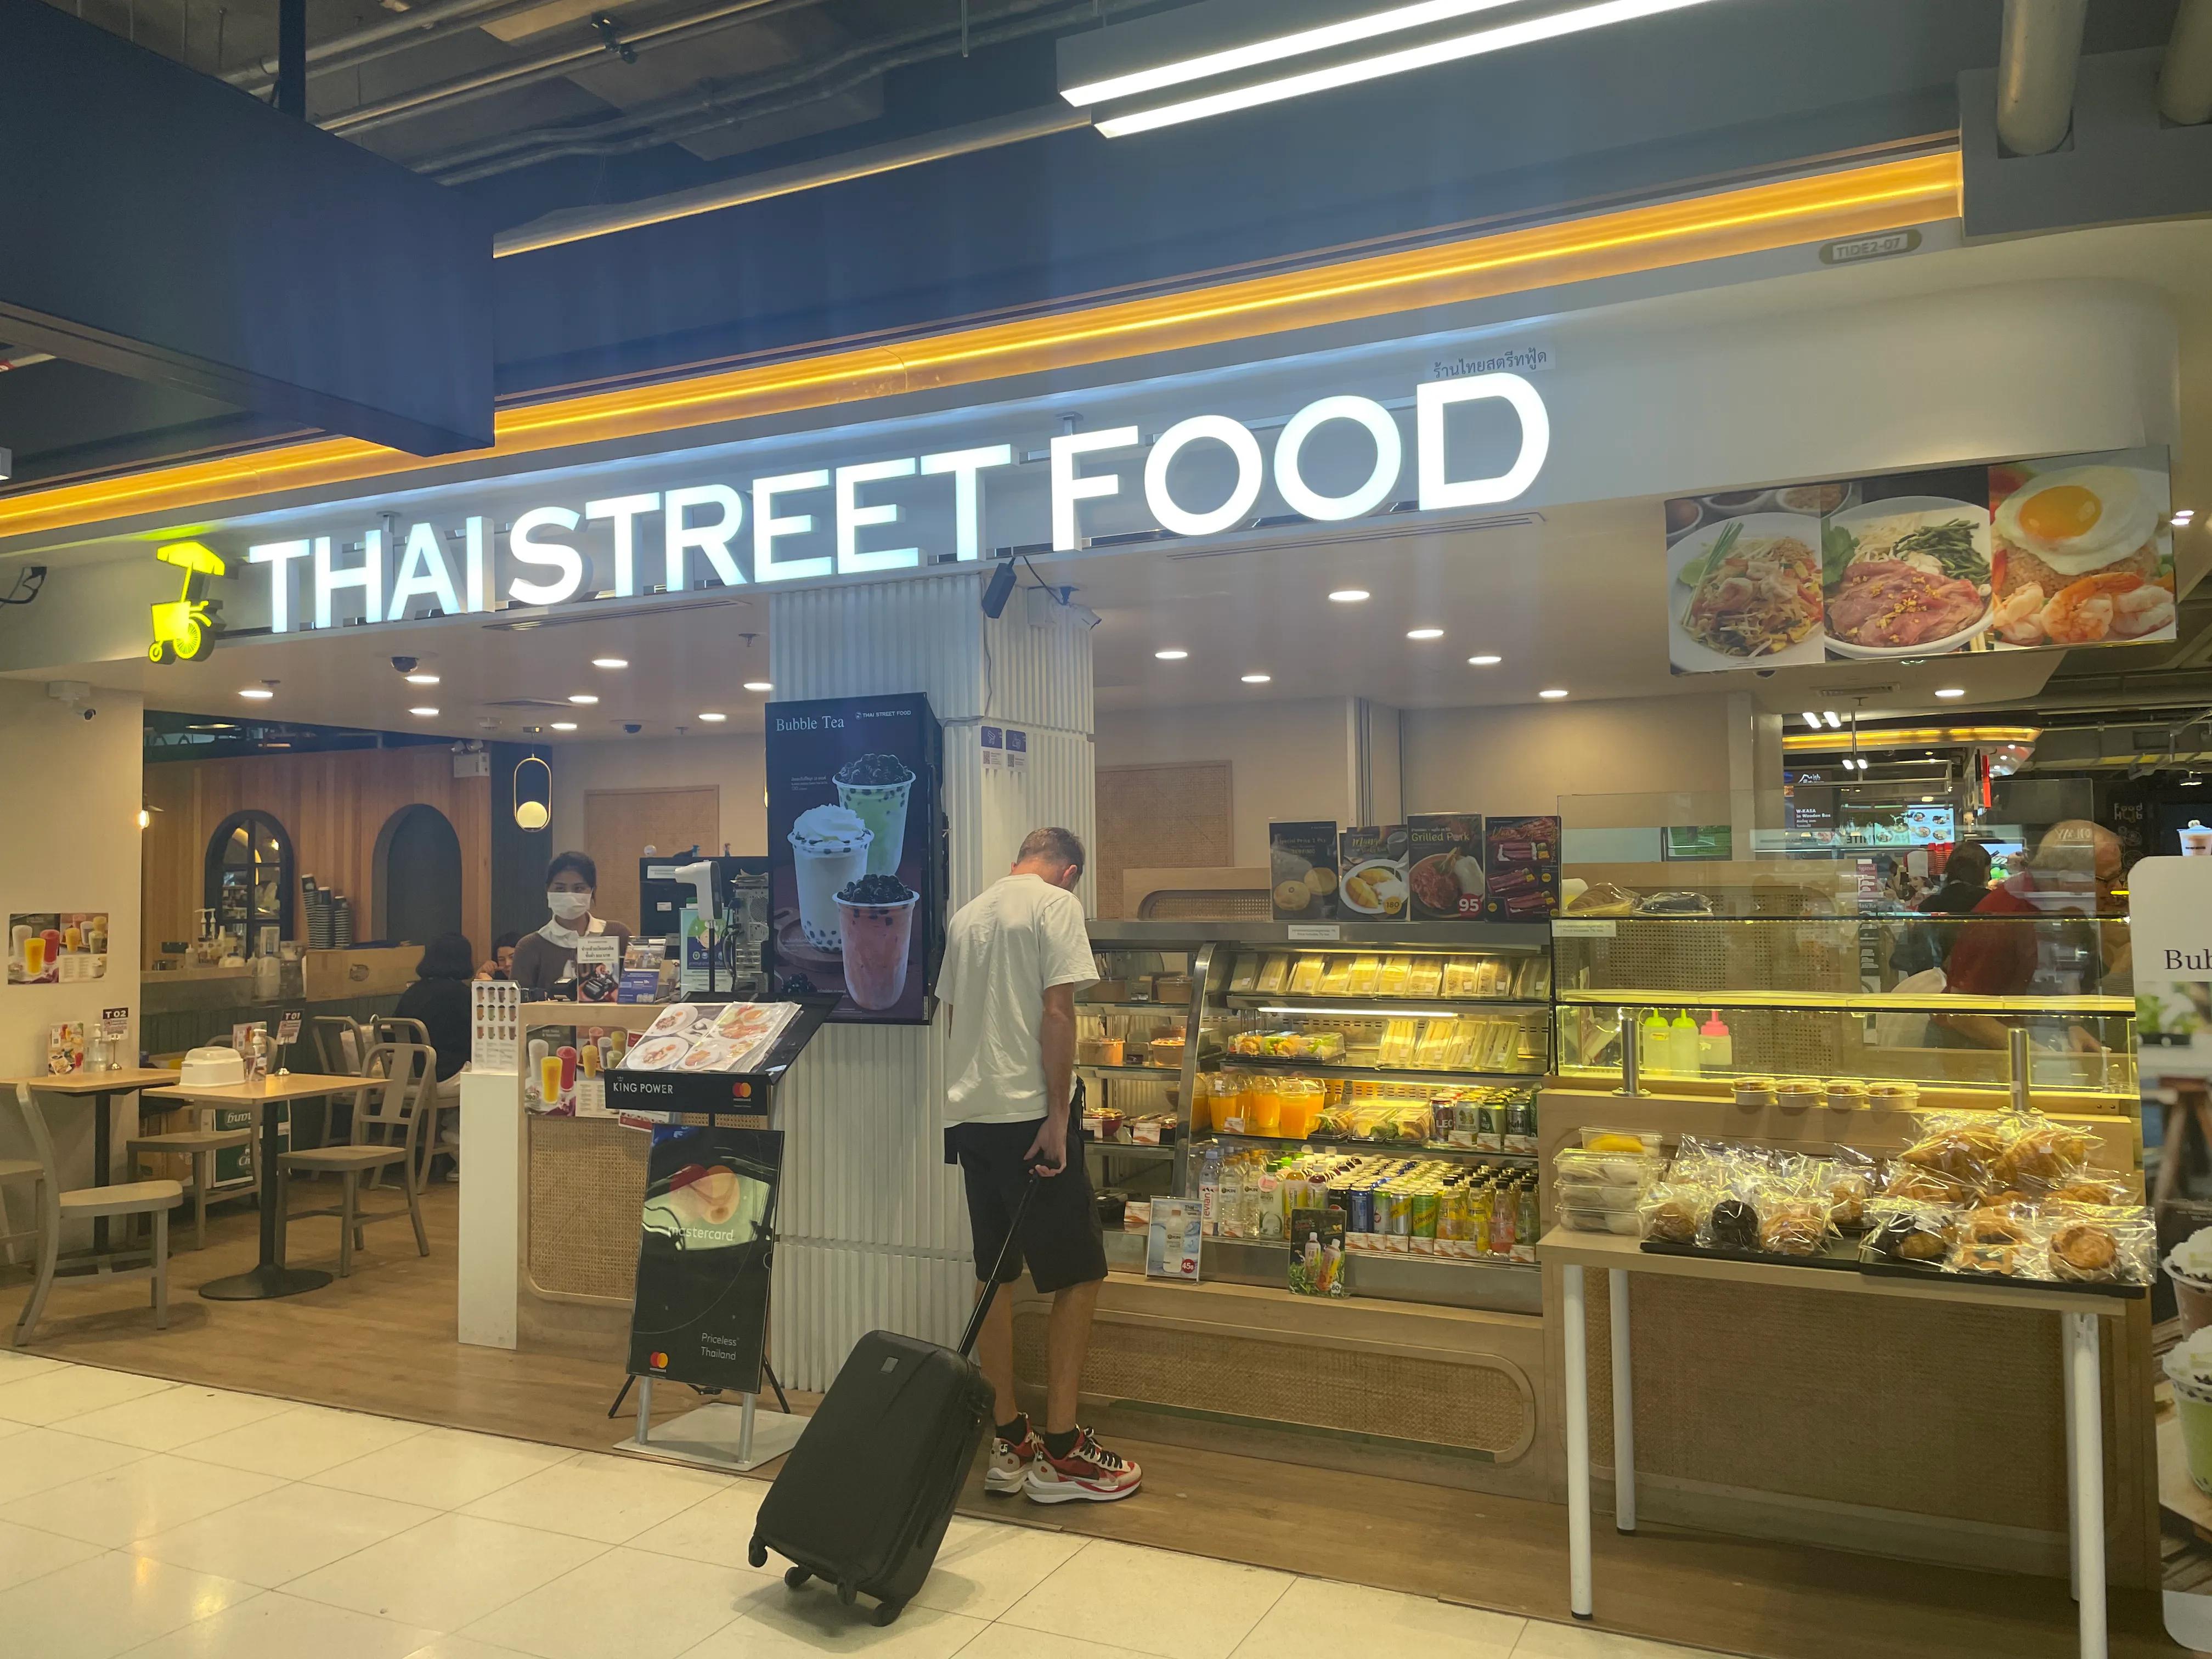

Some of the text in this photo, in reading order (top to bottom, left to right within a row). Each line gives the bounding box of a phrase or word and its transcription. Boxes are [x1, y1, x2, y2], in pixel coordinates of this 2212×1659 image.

[1433, 347, 1547, 379] ร้านไทยสตรีทฟู้ด
[249, 371, 1550, 633] THAI STREET FOOD
[776, 715, 844, 731] Bubble Tea
[1411, 832, 1470, 842] Grilled Pork
[1458, 898, 1480, 912] 95
[613, 1081, 674, 1094] KING POWER
[668, 1225, 733, 1242] mastercard
[702, 1332, 737, 1346] Priceless
[701, 1346, 736, 1361] Thailand
